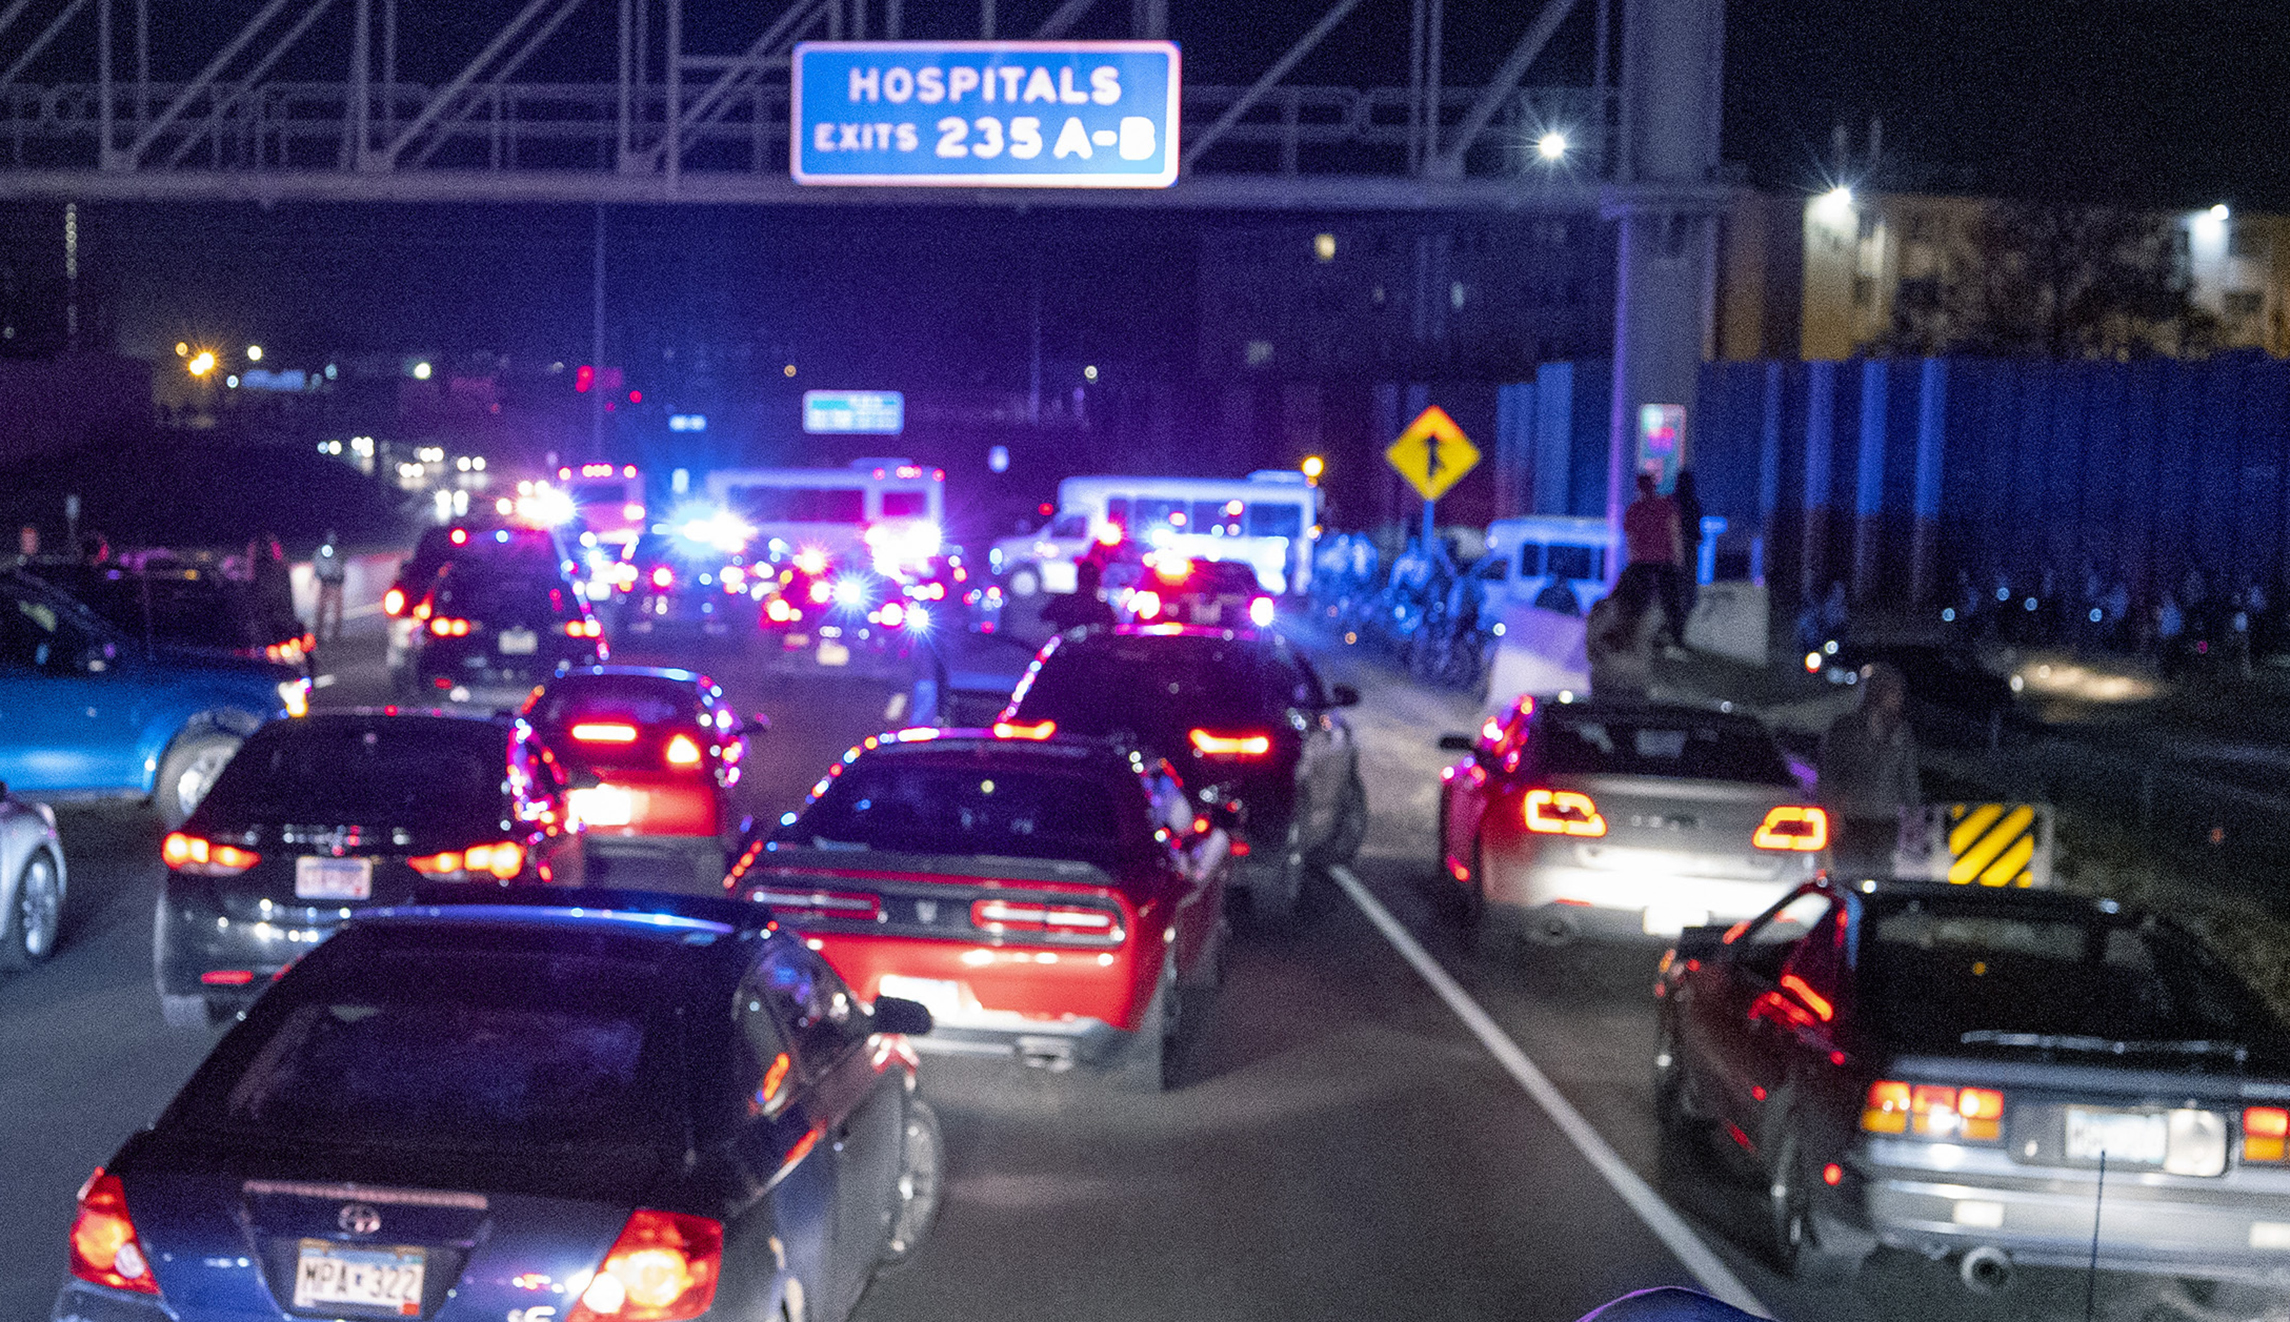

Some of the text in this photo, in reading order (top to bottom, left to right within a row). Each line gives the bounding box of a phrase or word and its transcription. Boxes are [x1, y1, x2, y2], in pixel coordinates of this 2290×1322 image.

[848, 66, 1122, 105] HOSPITALS
[813, 116, 1156, 160] EXITS 235 A-B
